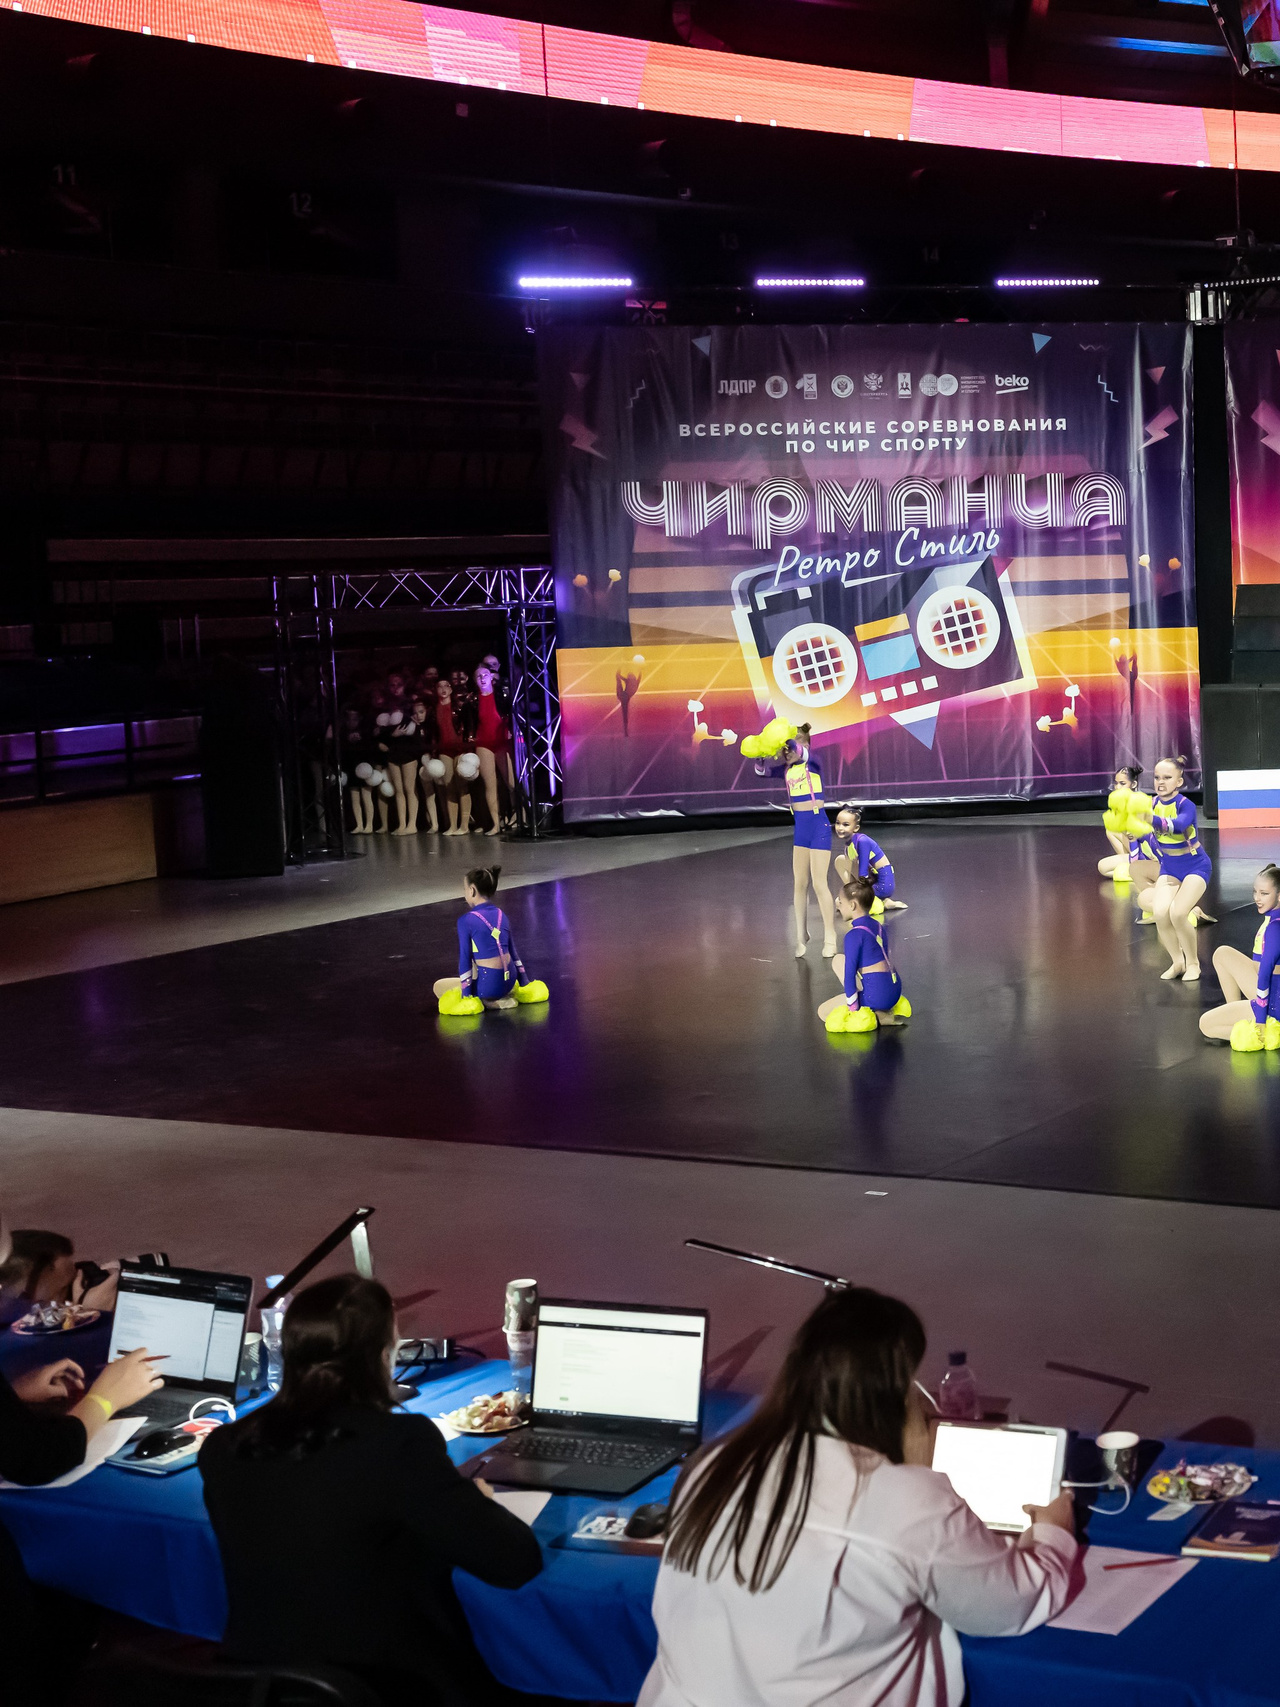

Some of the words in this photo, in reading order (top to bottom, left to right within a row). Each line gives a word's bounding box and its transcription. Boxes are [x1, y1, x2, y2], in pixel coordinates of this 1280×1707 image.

[717, 379, 757, 396] ЛДПР
[994, 374, 1030, 387] beko
[679, 418, 877, 437] ВСЕРОССИЙСКИЕ
[886, 417, 1067, 434] СОРЕВНОВАНИЯ
[785, 439, 816, 454] ПО
[826, 439, 871, 453] ЧИР
[880, 437, 968, 452] СПОРТУ
[773, 544, 881, 587] Ретро
[894, 526, 1000, 567] Стиль
